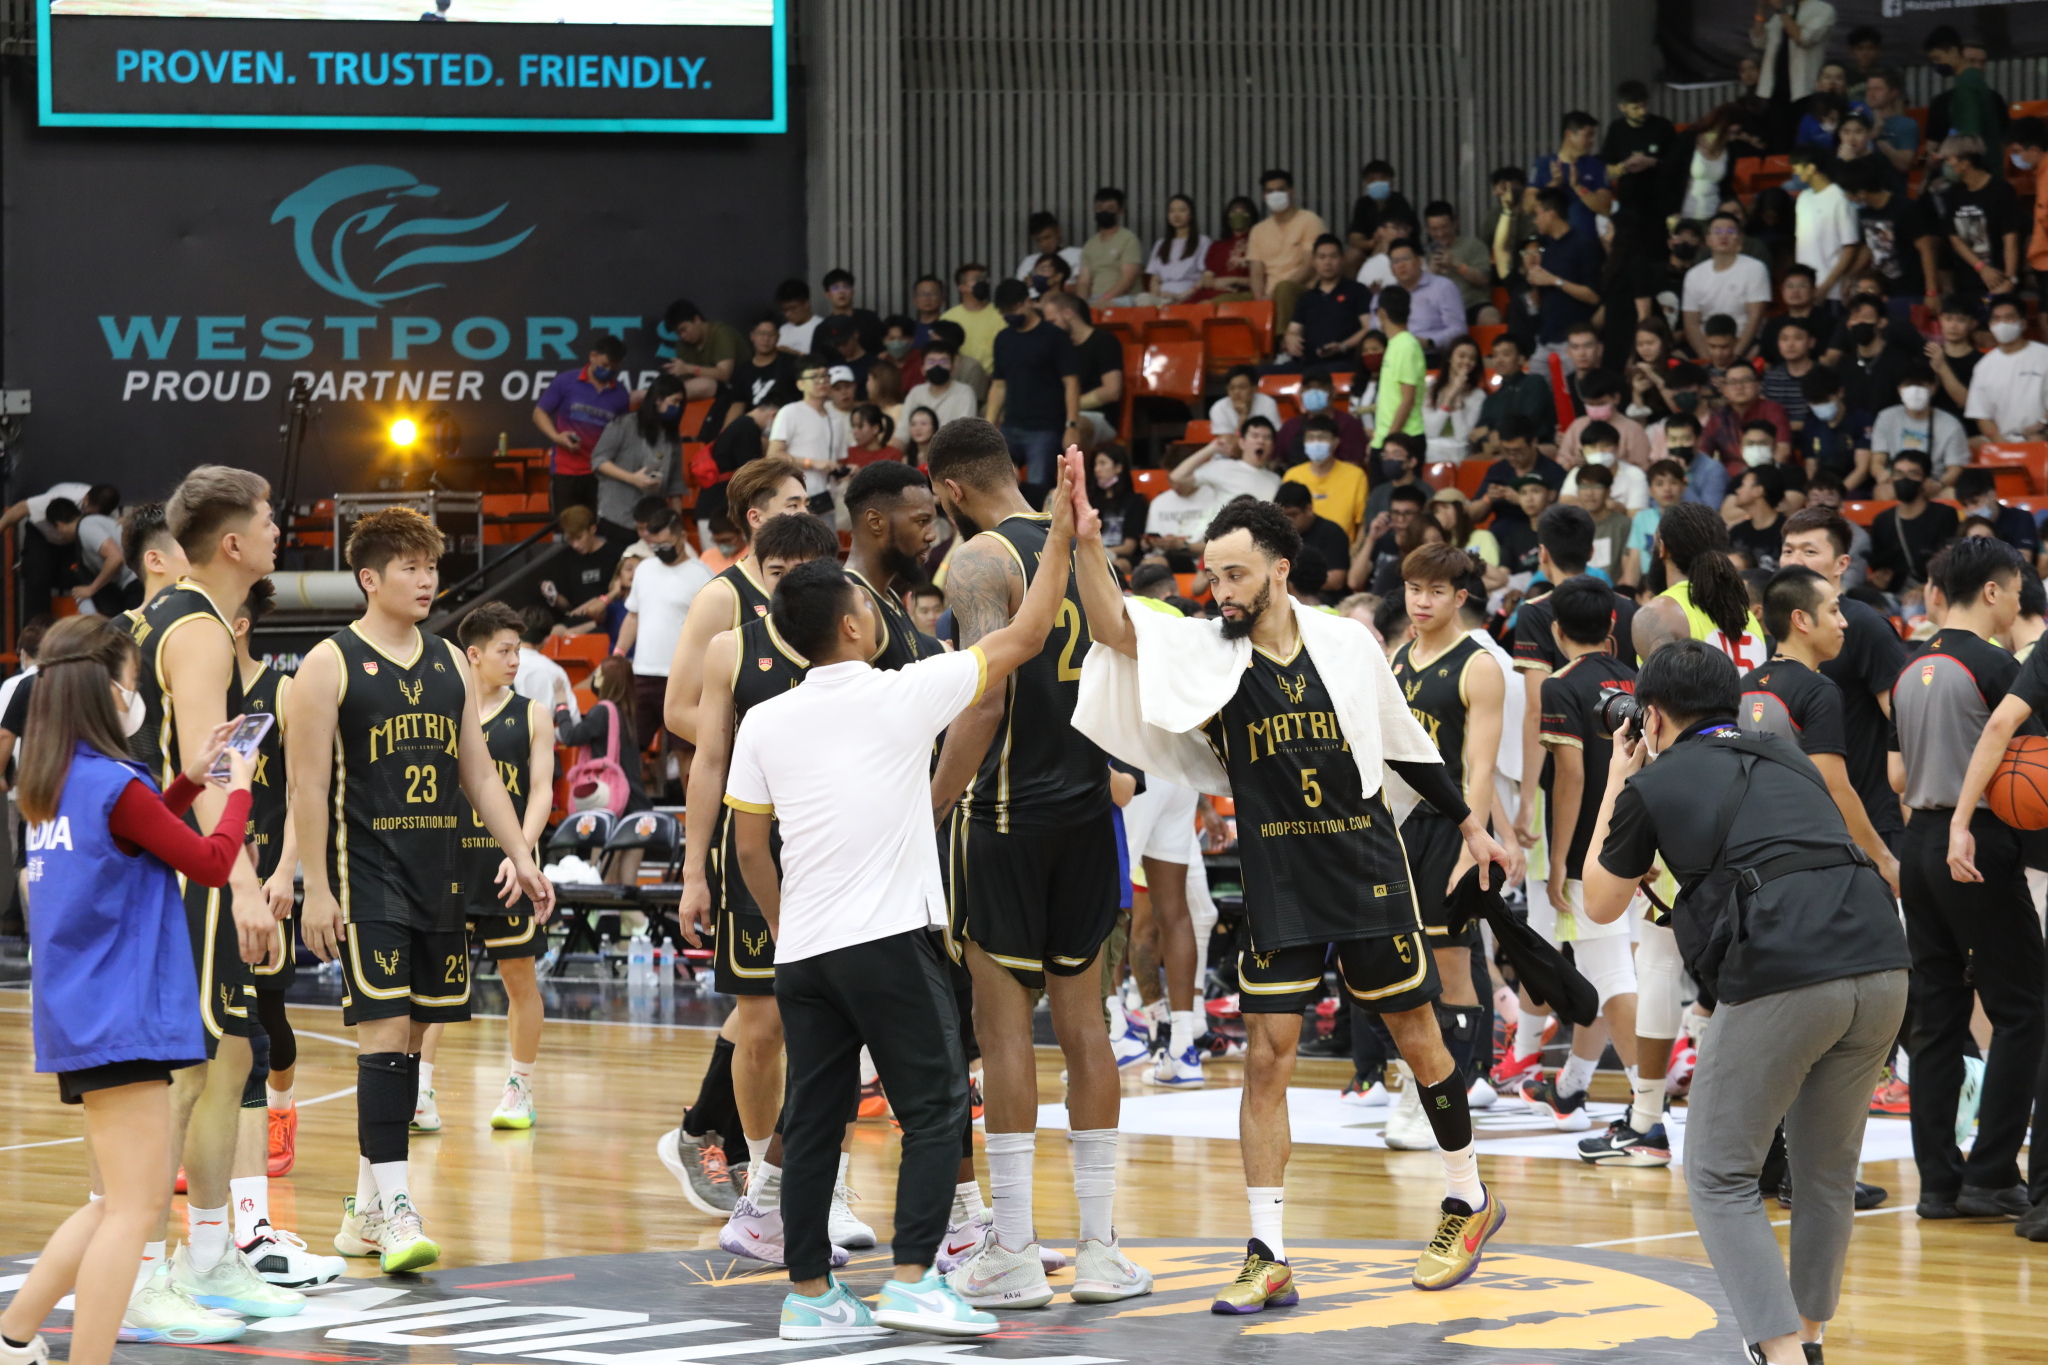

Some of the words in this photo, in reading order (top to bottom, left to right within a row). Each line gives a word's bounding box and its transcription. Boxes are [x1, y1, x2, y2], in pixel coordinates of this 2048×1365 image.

[117, 49, 297, 84] PROVEN.
[308, 52, 505, 87] TRUSTED.
[519, 54, 713, 90] FRIENDLY.
[122, 371, 271, 402] PROUD
[289, 371, 485, 402] PARTNER
[501, 371, 557, 402] OF
[1054, 598, 1095, 683] 2
[369, 713, 459, 764] MATRIX
[405, 764, 438, 803] 23
[1300, 768, 1323, 808] 5
[372, 815, 458, 831] HOOPSSTATION.COM
[1260, 814, 1372, 838] HOOPSSTATION.COM
[1392, 934, 1412, 964] 5
